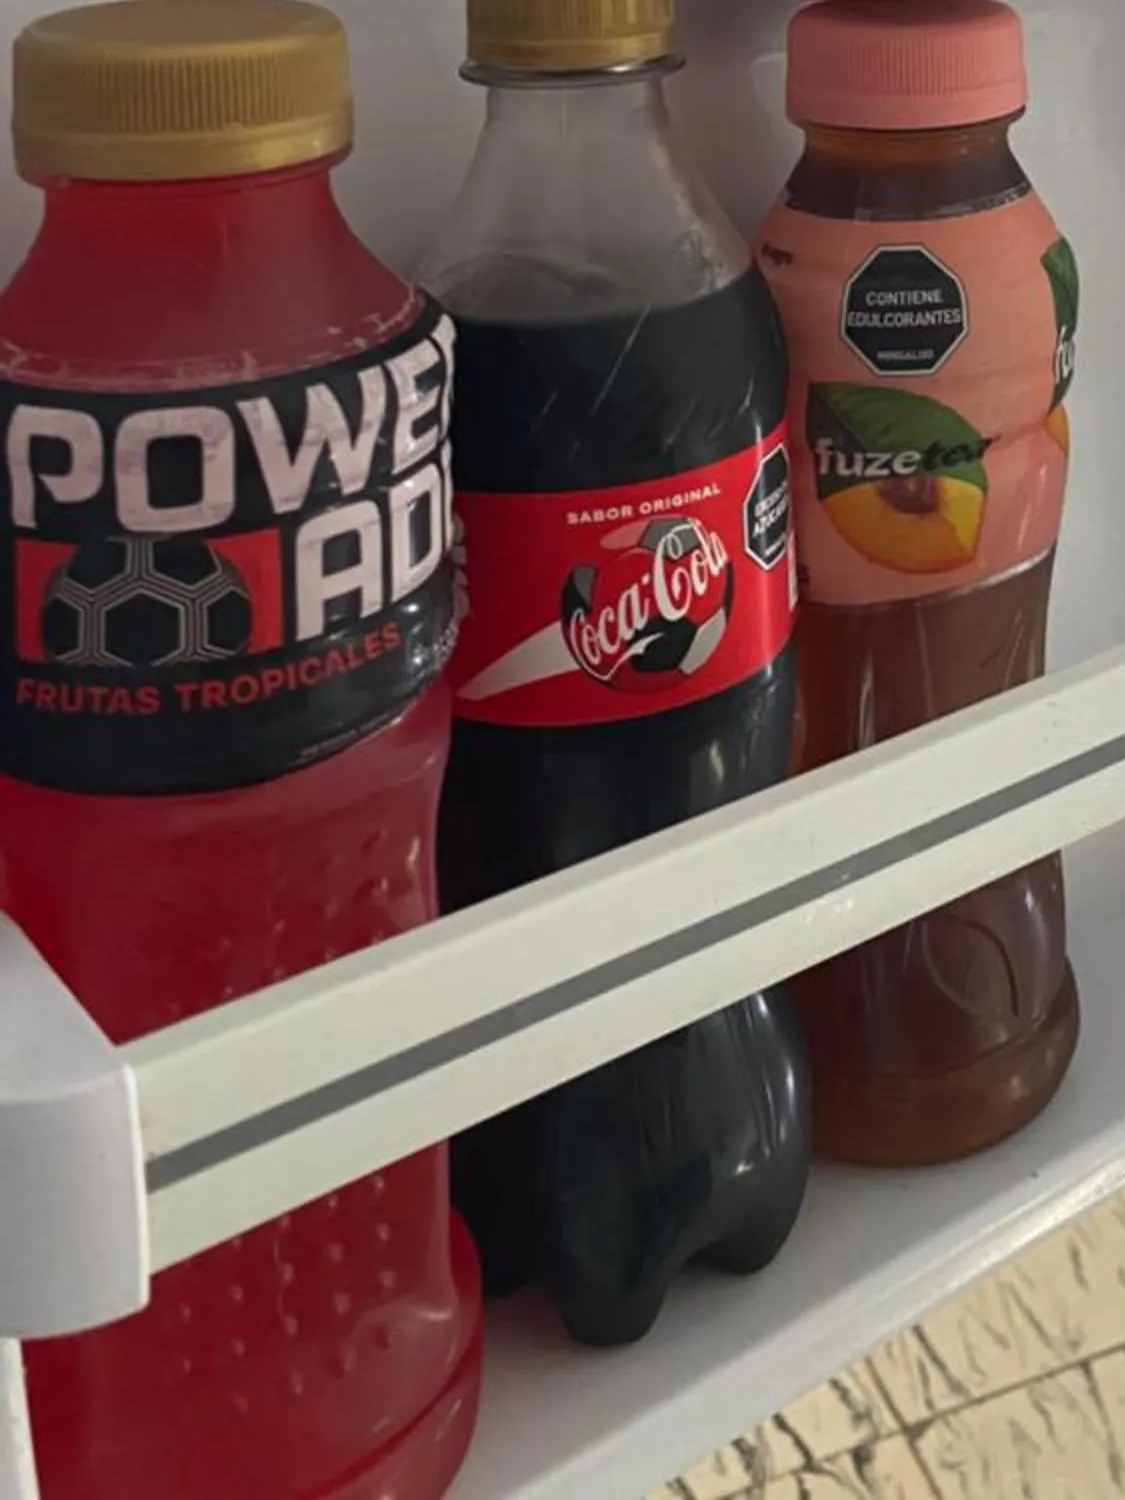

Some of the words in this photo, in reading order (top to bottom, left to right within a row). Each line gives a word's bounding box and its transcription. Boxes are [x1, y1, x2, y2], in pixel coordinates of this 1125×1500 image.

[847, 307, 962, 329] EDULCORANTES
[865, 288, 944, 307] CONTIENE
[814, 437, 922, 477] fuze
[566, 504, 634, 526] SABOR
[638, 481, 722, 515] ORIGINAL
[569, 522, 728, 666] Coca-Cola
[15, 676, 161, 715] FRUTAS
[175, 622, 401, 709] TROPICALES
